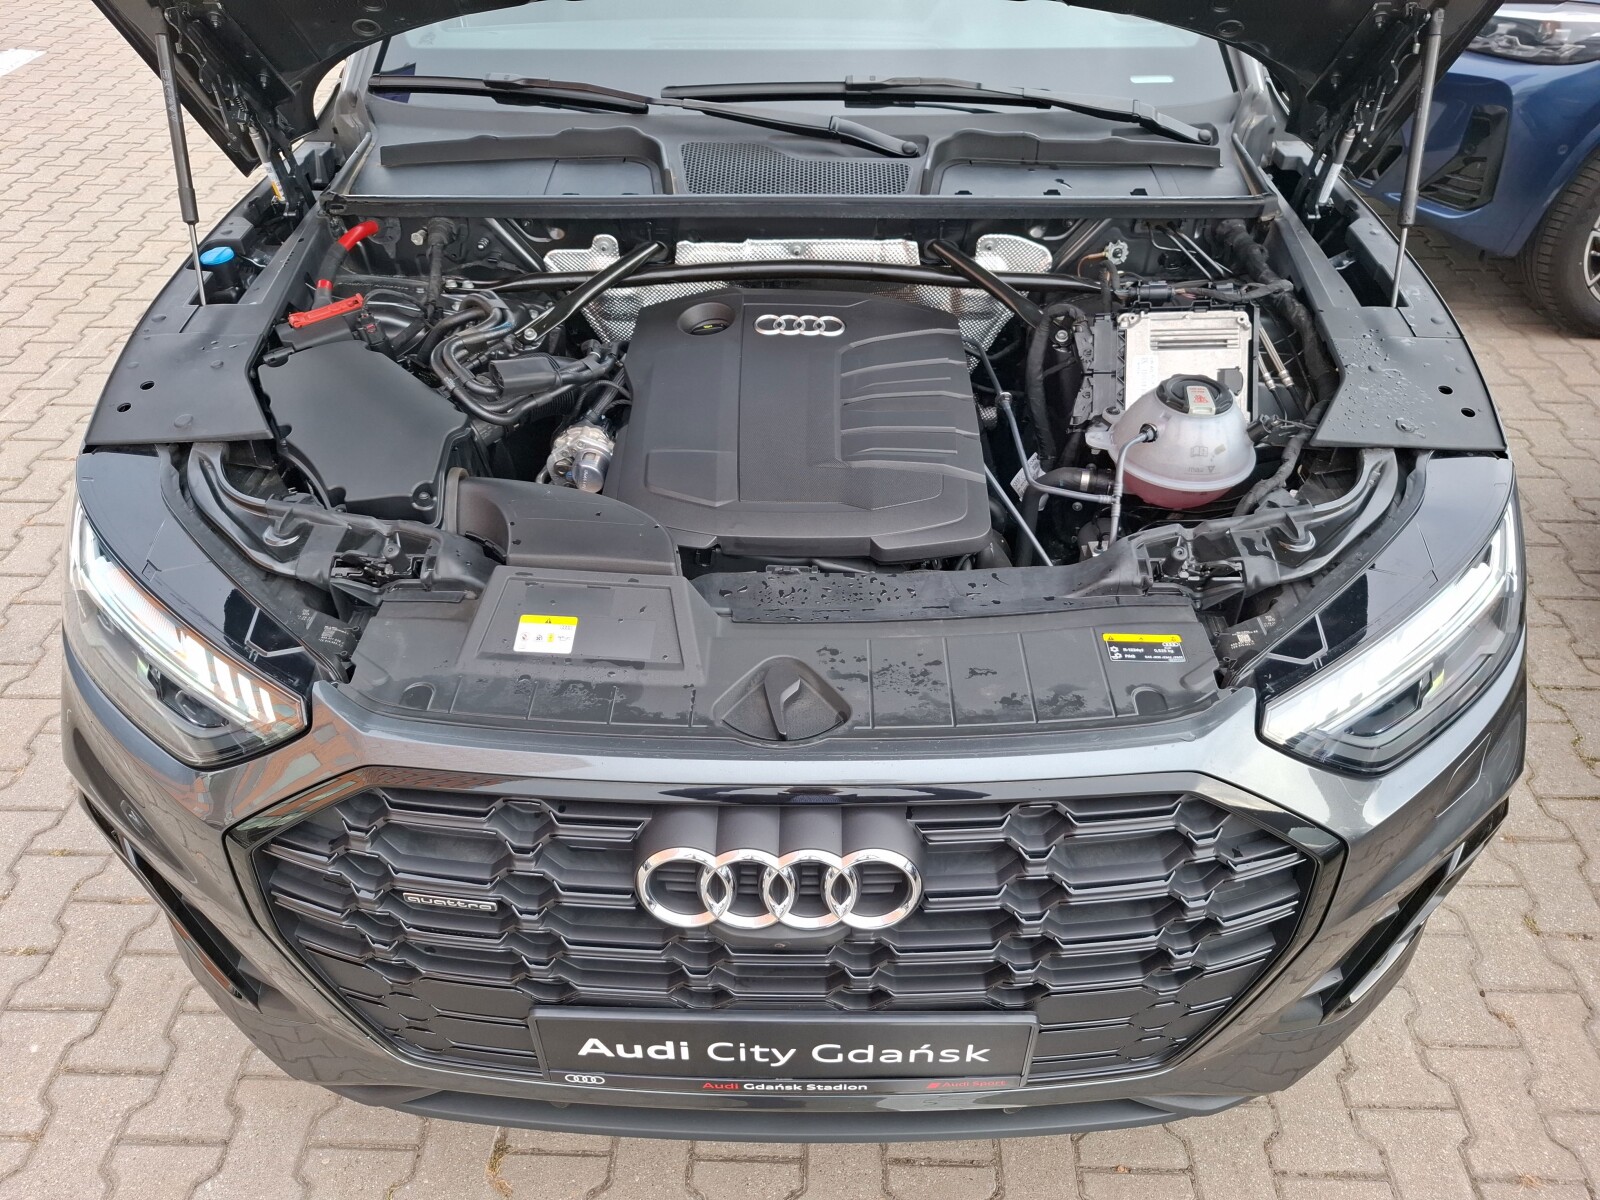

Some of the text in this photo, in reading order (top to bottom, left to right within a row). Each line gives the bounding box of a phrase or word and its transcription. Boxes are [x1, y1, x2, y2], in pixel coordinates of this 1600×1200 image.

[407, 895, 492, 910] quattro
[577, 1037, 991, 1067] Audi City Gdańsk
[702, 1081, 868, 1092] Audi Gdańsk Stadion
[942, 1080, 1009, 1089] Audi Sport
